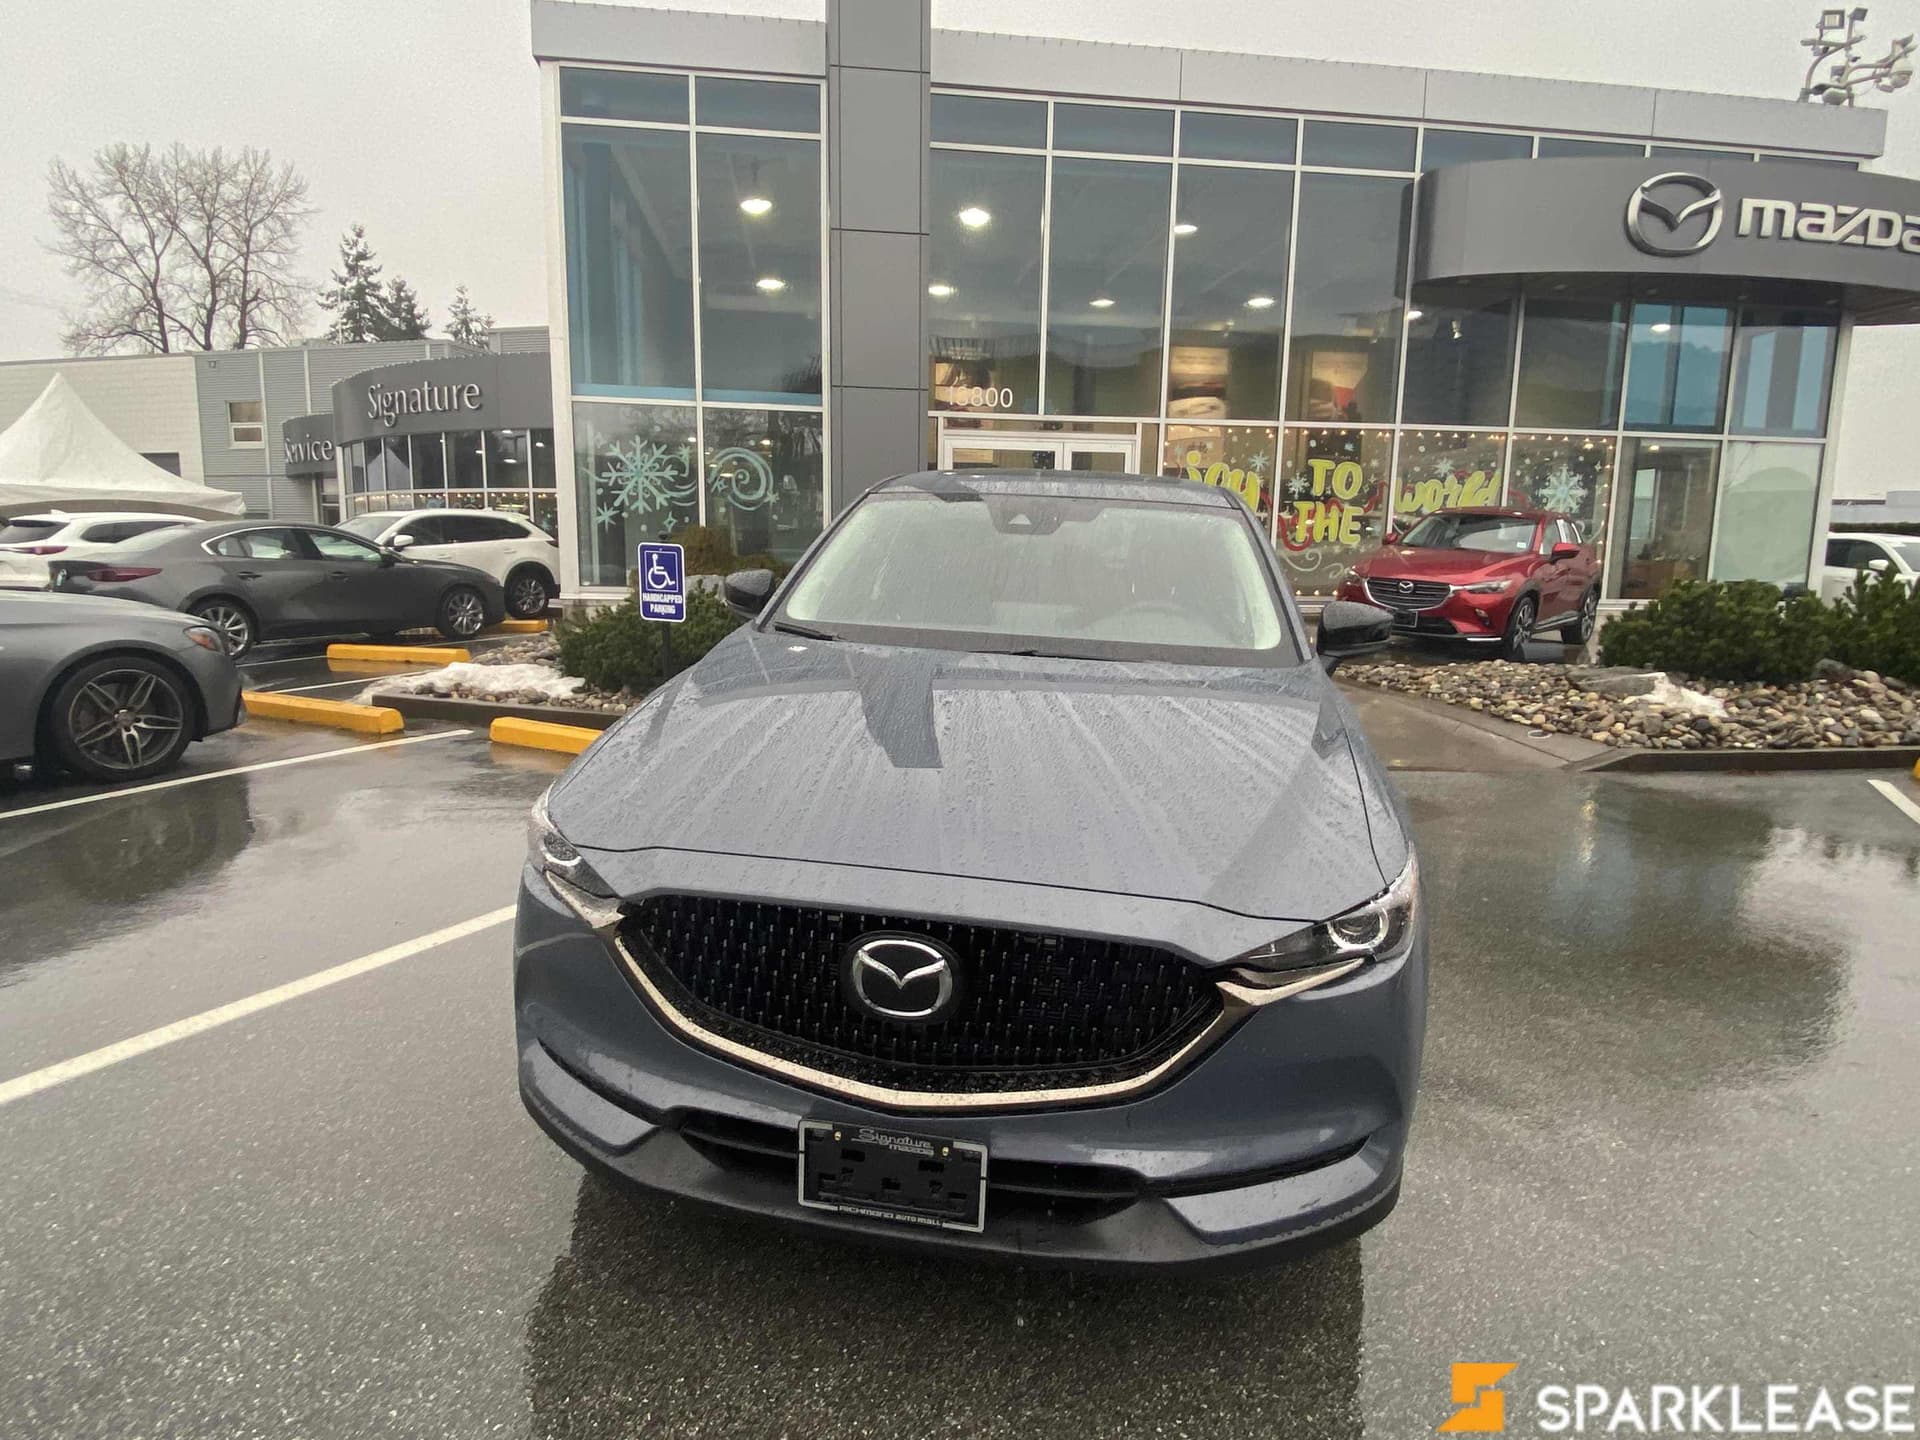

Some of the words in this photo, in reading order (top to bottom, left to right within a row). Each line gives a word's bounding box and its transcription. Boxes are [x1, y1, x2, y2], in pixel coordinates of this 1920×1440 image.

[367, 381, 481, 428] Signature
[284, 433, 334, 464] Service
[1308, 458, 1363, 500] TO
[1293, 500, 1364, 545] THE
[642, 592, 683, 604] HANDICAPPED
[650, 603, 676, 615] PARKING
[858, 1127, 934, 1149] Signature
